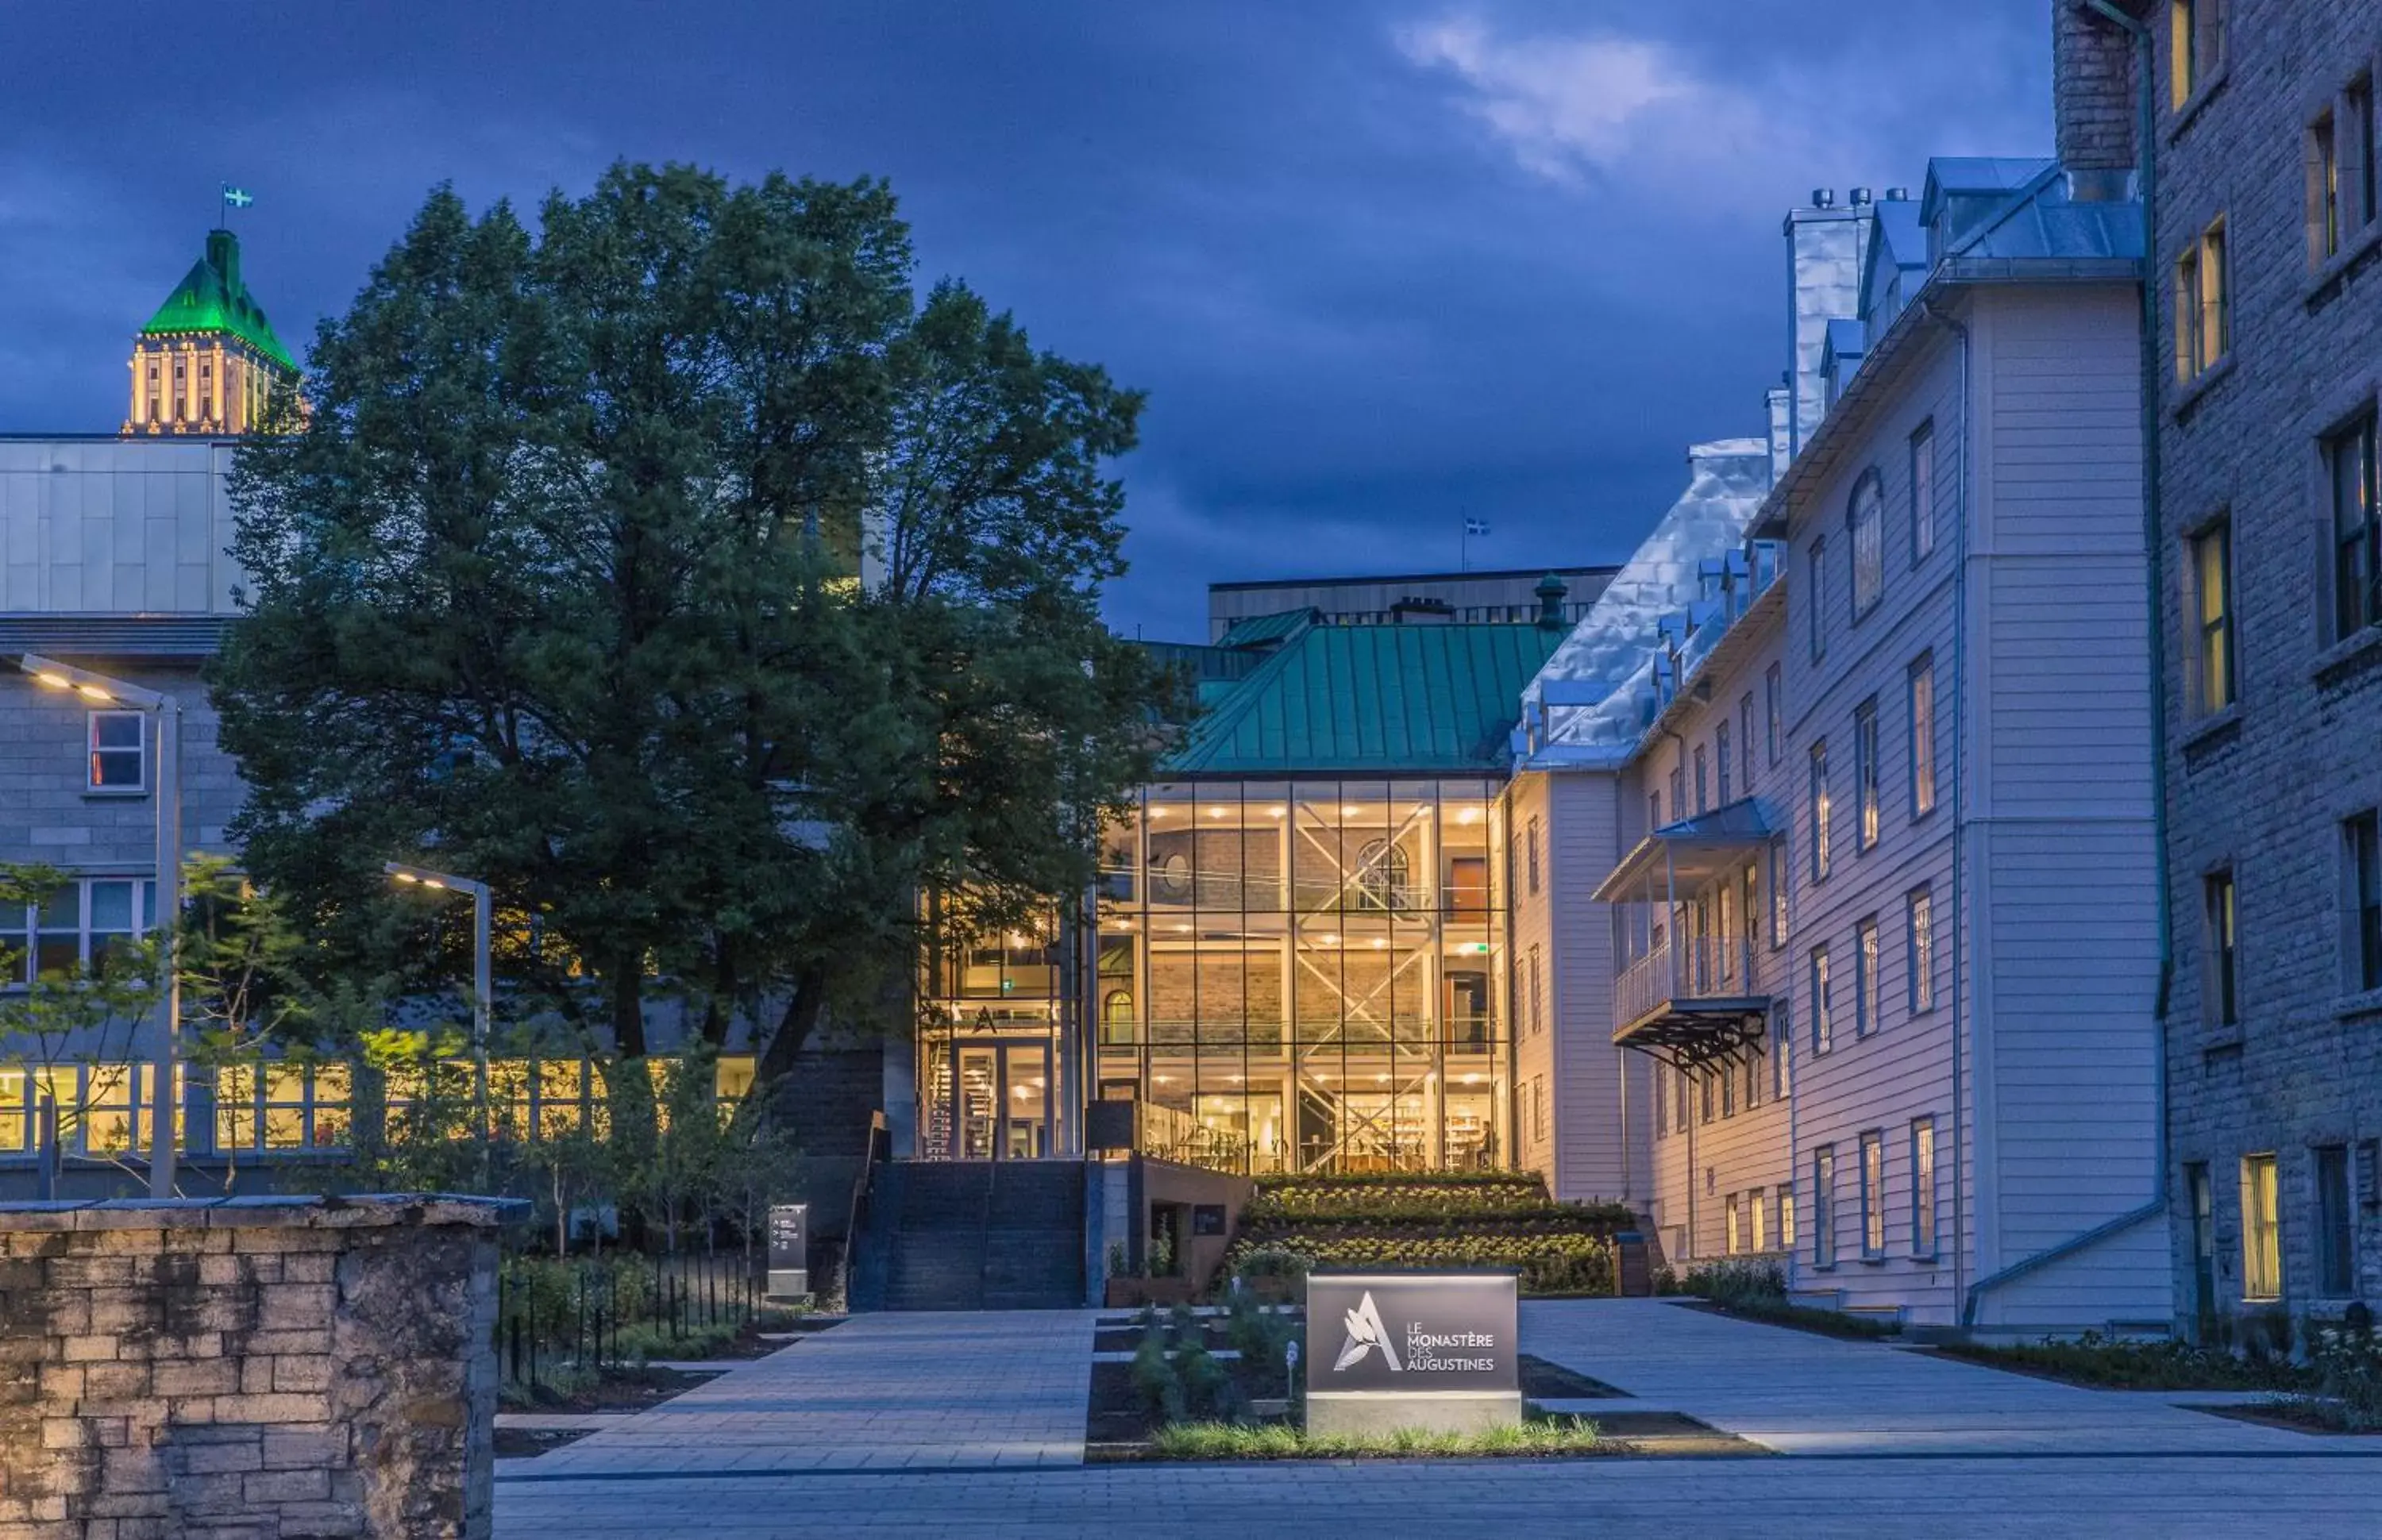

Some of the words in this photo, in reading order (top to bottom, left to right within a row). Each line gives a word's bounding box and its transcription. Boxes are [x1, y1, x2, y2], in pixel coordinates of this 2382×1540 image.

[1407, 1321, 1423, 1334] LE
[1407, 1331, 1494, 1347] MONASTÈRE
[1408, 1346, 1433, 1359] DES
[1406, 1358, 1494, 1371] AUGUSTINES
